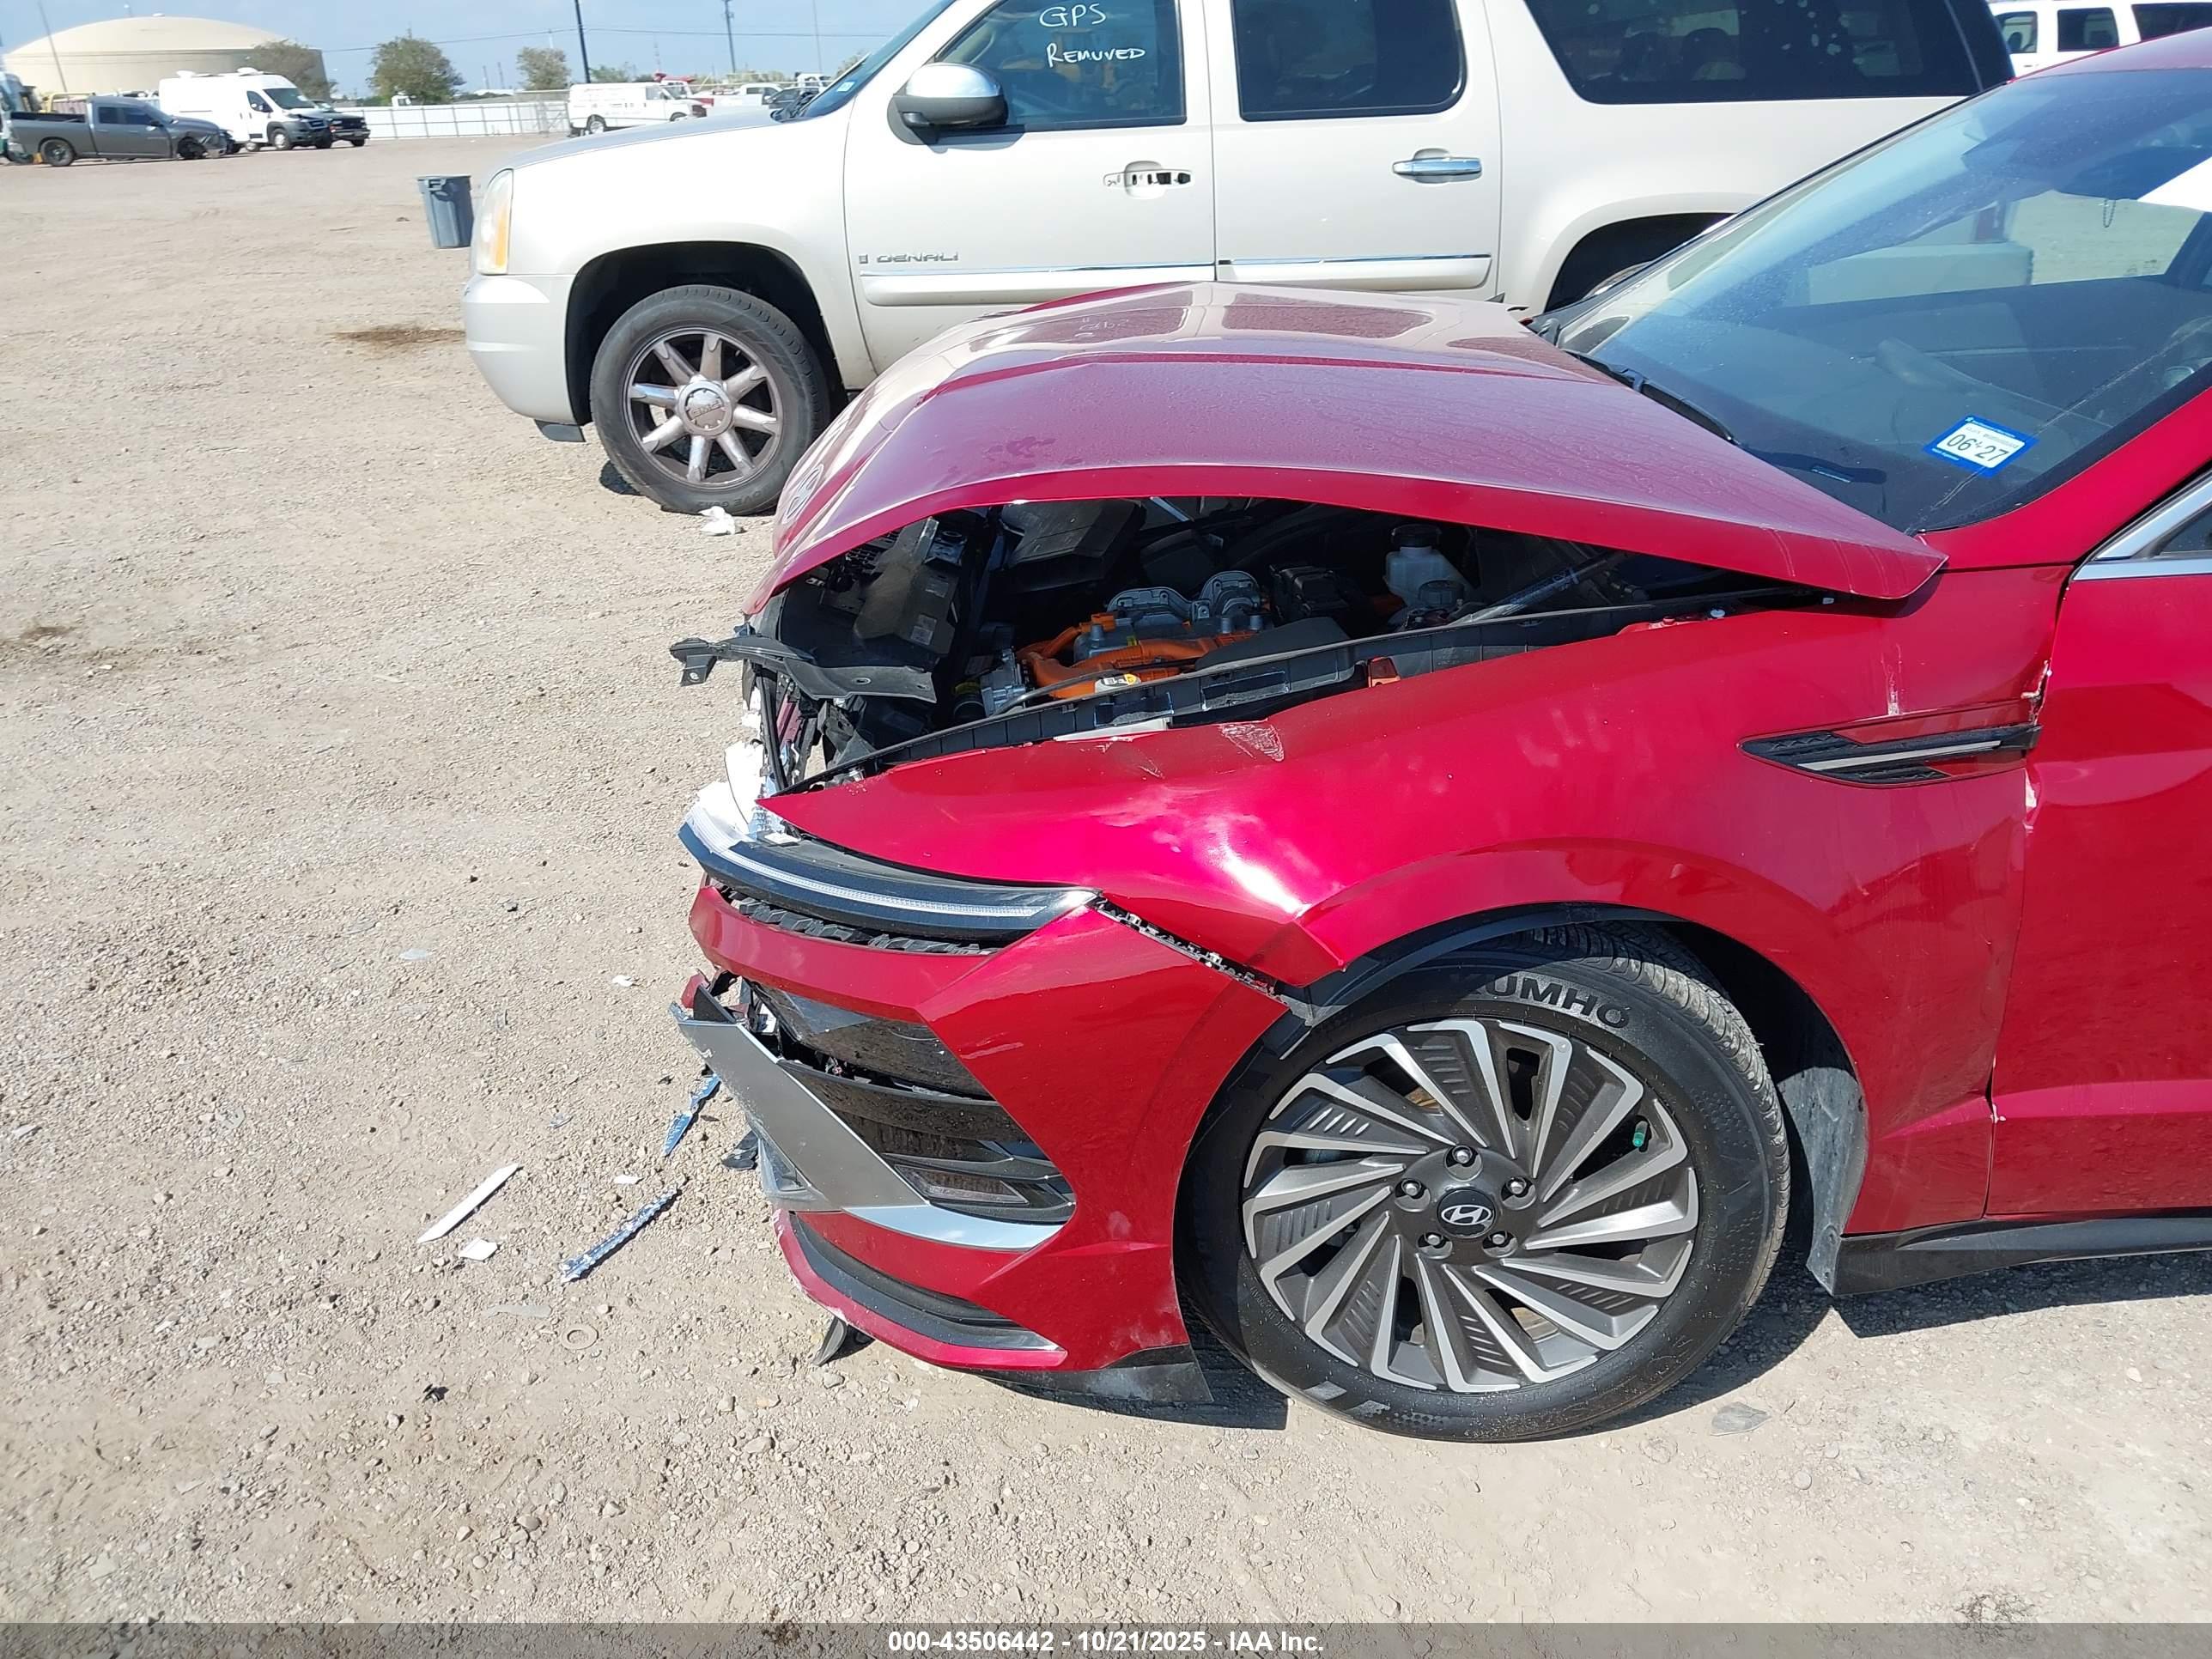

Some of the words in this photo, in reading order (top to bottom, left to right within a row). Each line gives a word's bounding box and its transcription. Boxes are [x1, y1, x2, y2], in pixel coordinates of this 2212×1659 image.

[1039, 3, 1107, 27] GPS
[876, 251, 959, 263] DENALI
[1946, 434, 1978, 452] 06
[1974, 445, 2010, 462] 27
[1470, 975, 1632, 1030] UMHO
